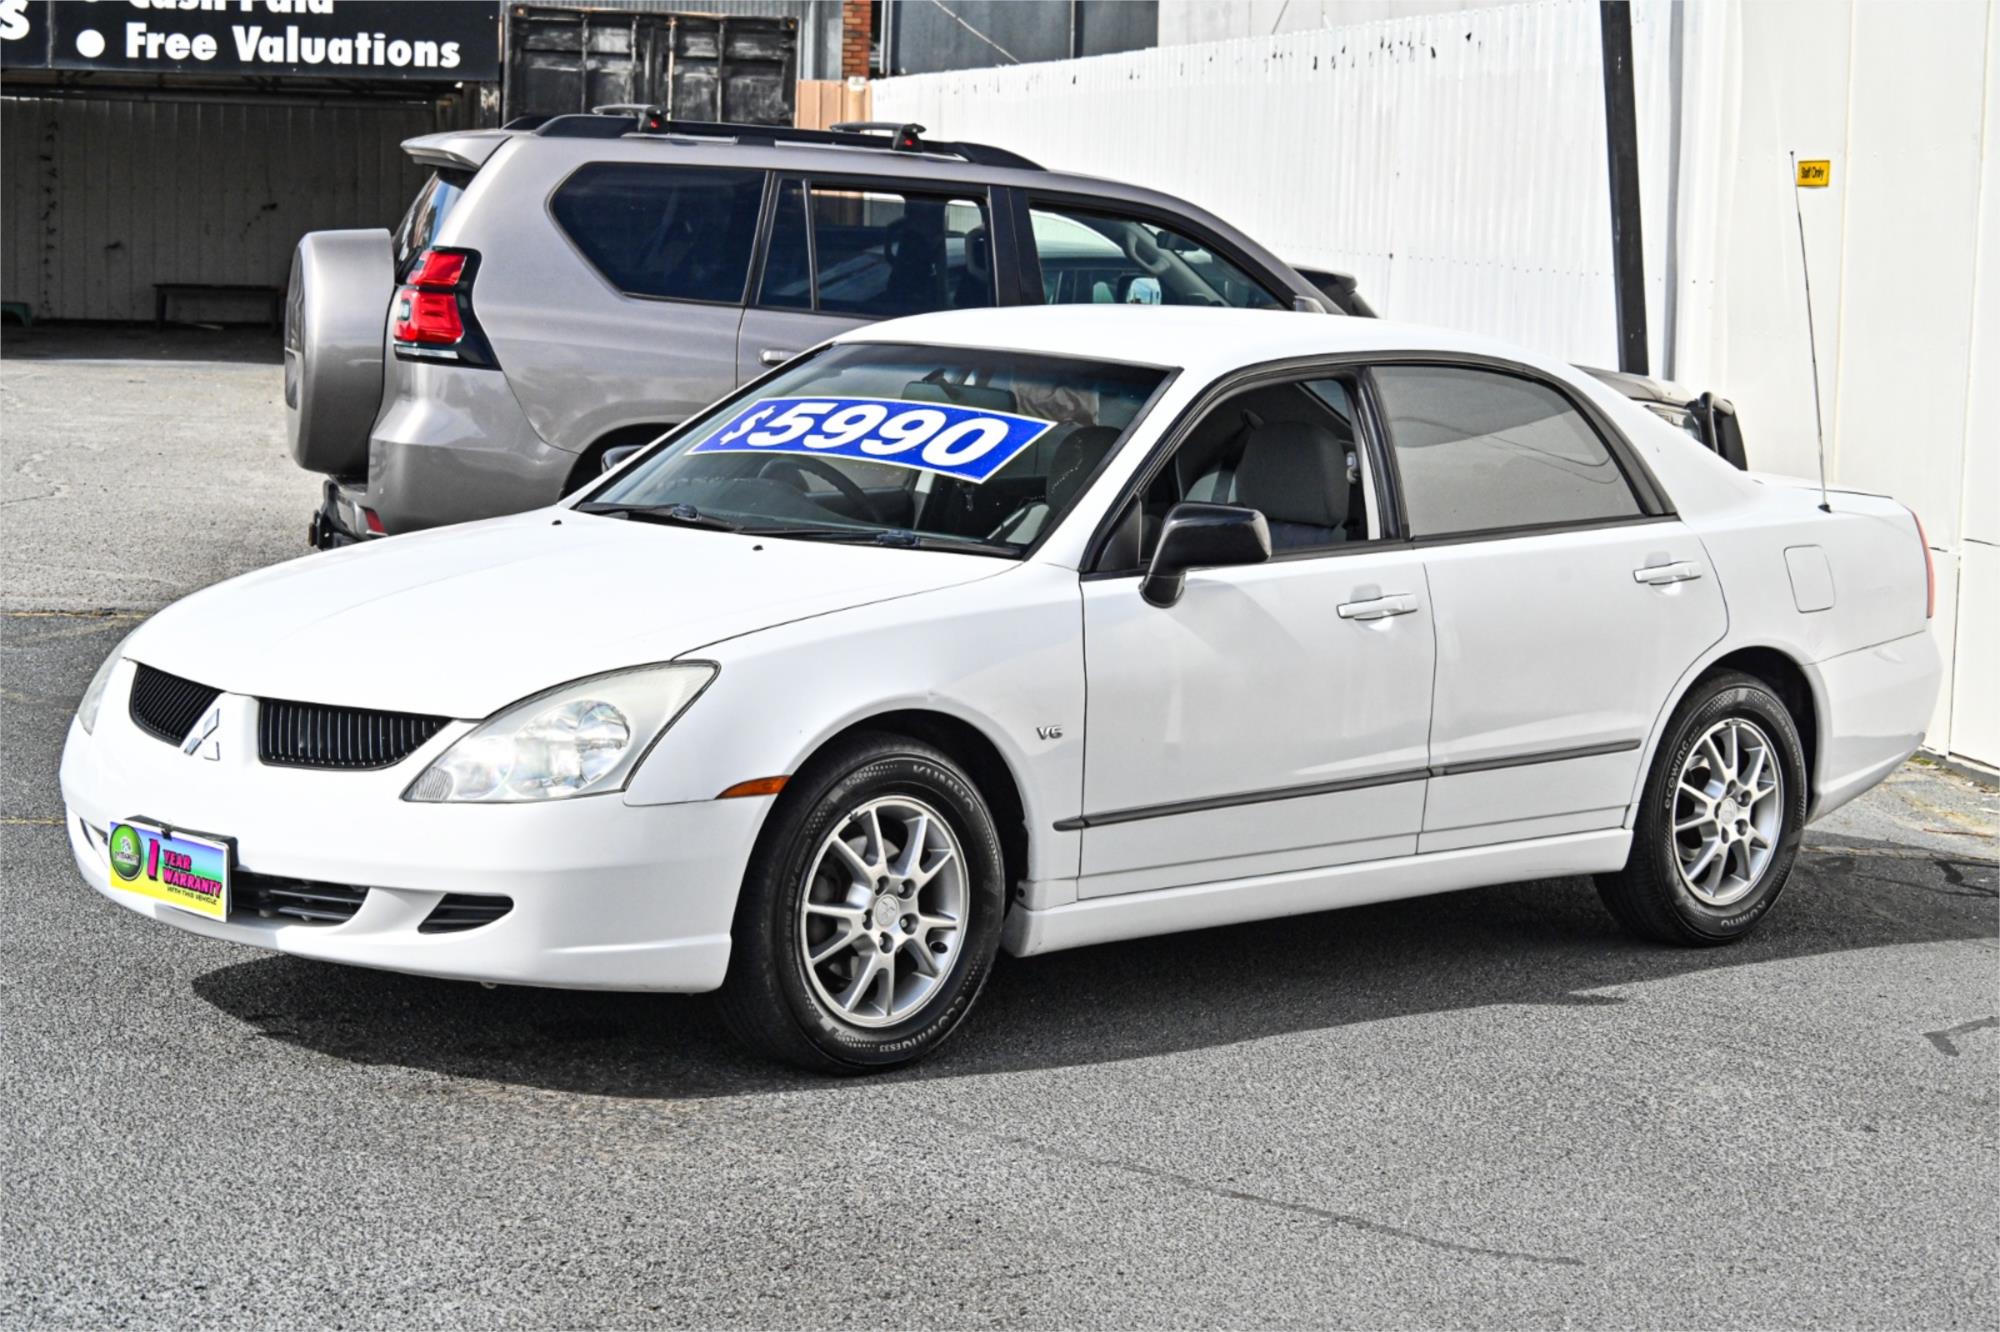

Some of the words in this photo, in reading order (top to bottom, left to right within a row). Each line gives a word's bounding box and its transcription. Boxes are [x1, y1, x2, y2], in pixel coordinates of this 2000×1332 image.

[126, 22, 217, 61] Free
[232, 25, 461, 68] Valuations
[720, 402, 1009, 466] $5990
[1036, 727, 1063, 740] V6
[146, 838, 160, 881] 1
[163, 849, 192, 872] YEAR
[163, 866, 223, 899] WARRANTY
